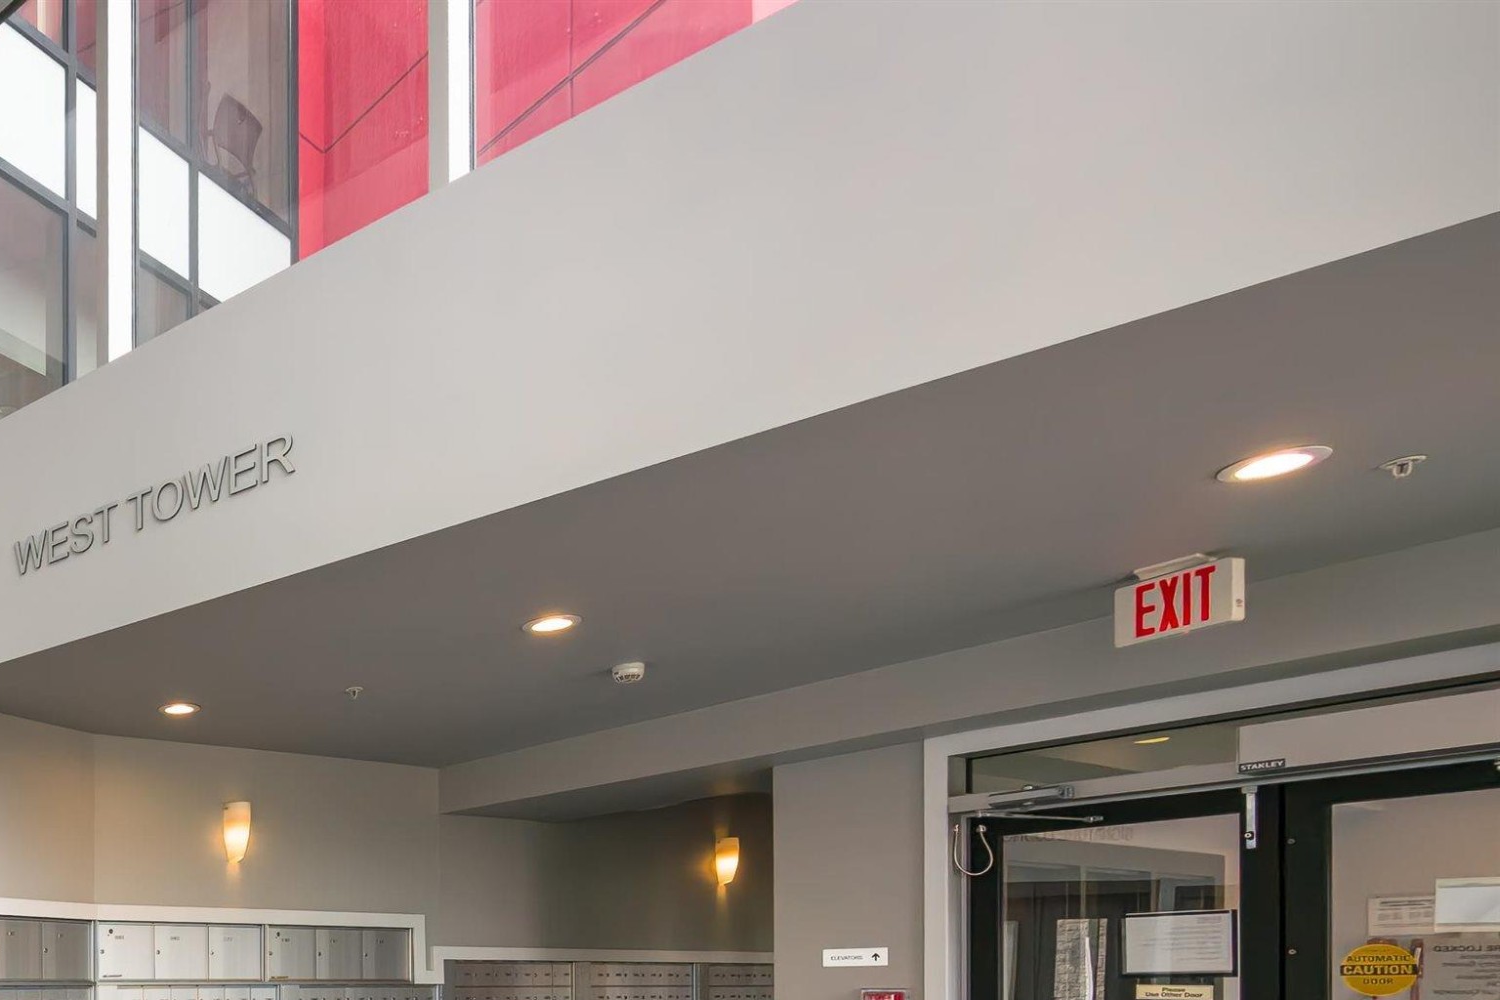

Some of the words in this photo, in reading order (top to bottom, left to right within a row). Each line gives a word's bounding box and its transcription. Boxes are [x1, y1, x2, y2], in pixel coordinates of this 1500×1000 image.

[13, 503, 118, 575] WEST
[127, 432, 296, 532] TOWER
[1135, 565, 1216, 638] EXIT
[1343, 965, 1413, 975] CAUTION
[1346, 954, 1411, 963] AUTOMATIC
